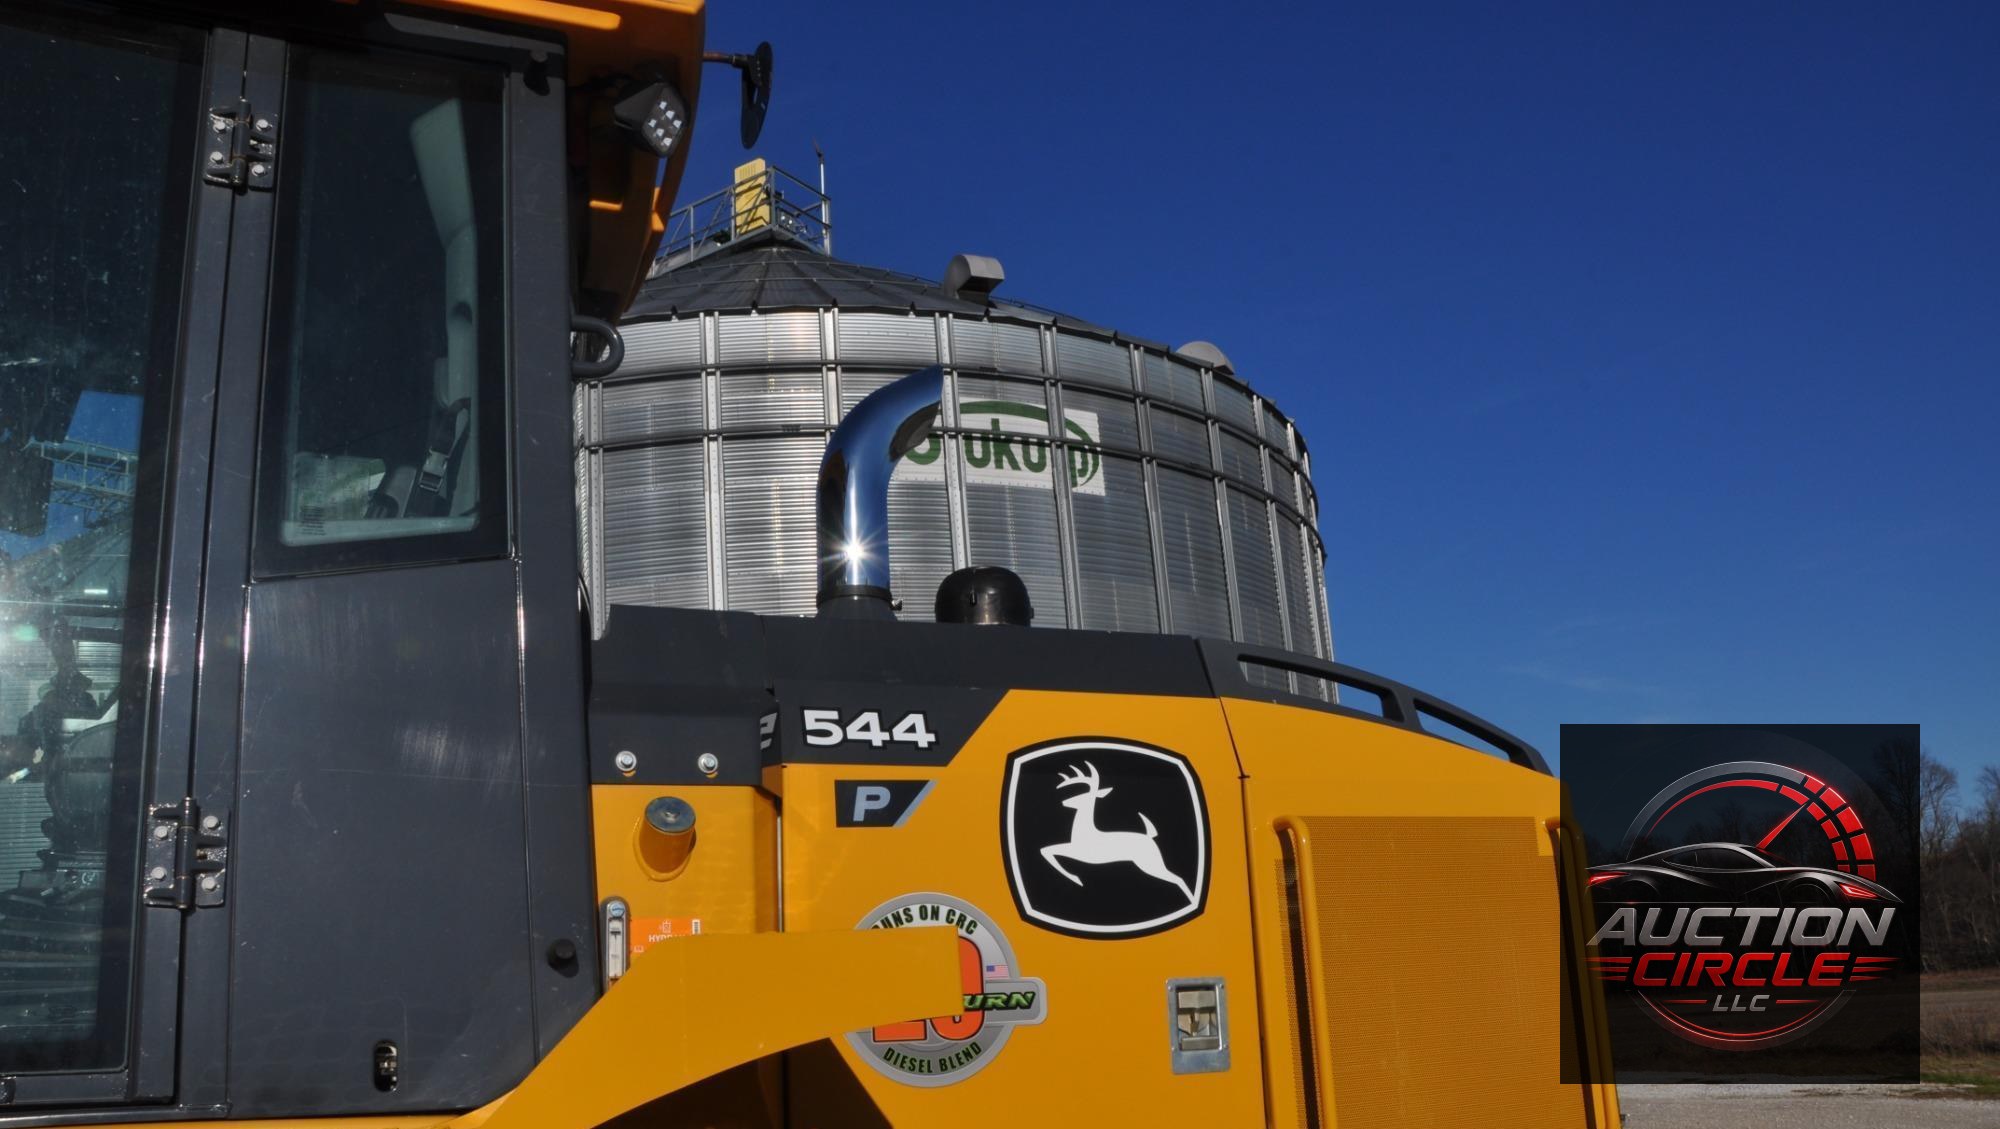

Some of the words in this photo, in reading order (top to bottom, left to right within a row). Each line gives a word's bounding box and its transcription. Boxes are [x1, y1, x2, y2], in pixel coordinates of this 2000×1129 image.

[803, 709, 937, 748] 544
[853, 786, 891, 822] P
[871, 907, 914, 929] UNS
[919, 905, 940, 921] ON
[945, 909, 978, 935] CRC
[963, 992, 1036, 1011] URN
[883, 1047, 934, 1074] DIESEL
[938, 1041, 982, 1073] BLEND
